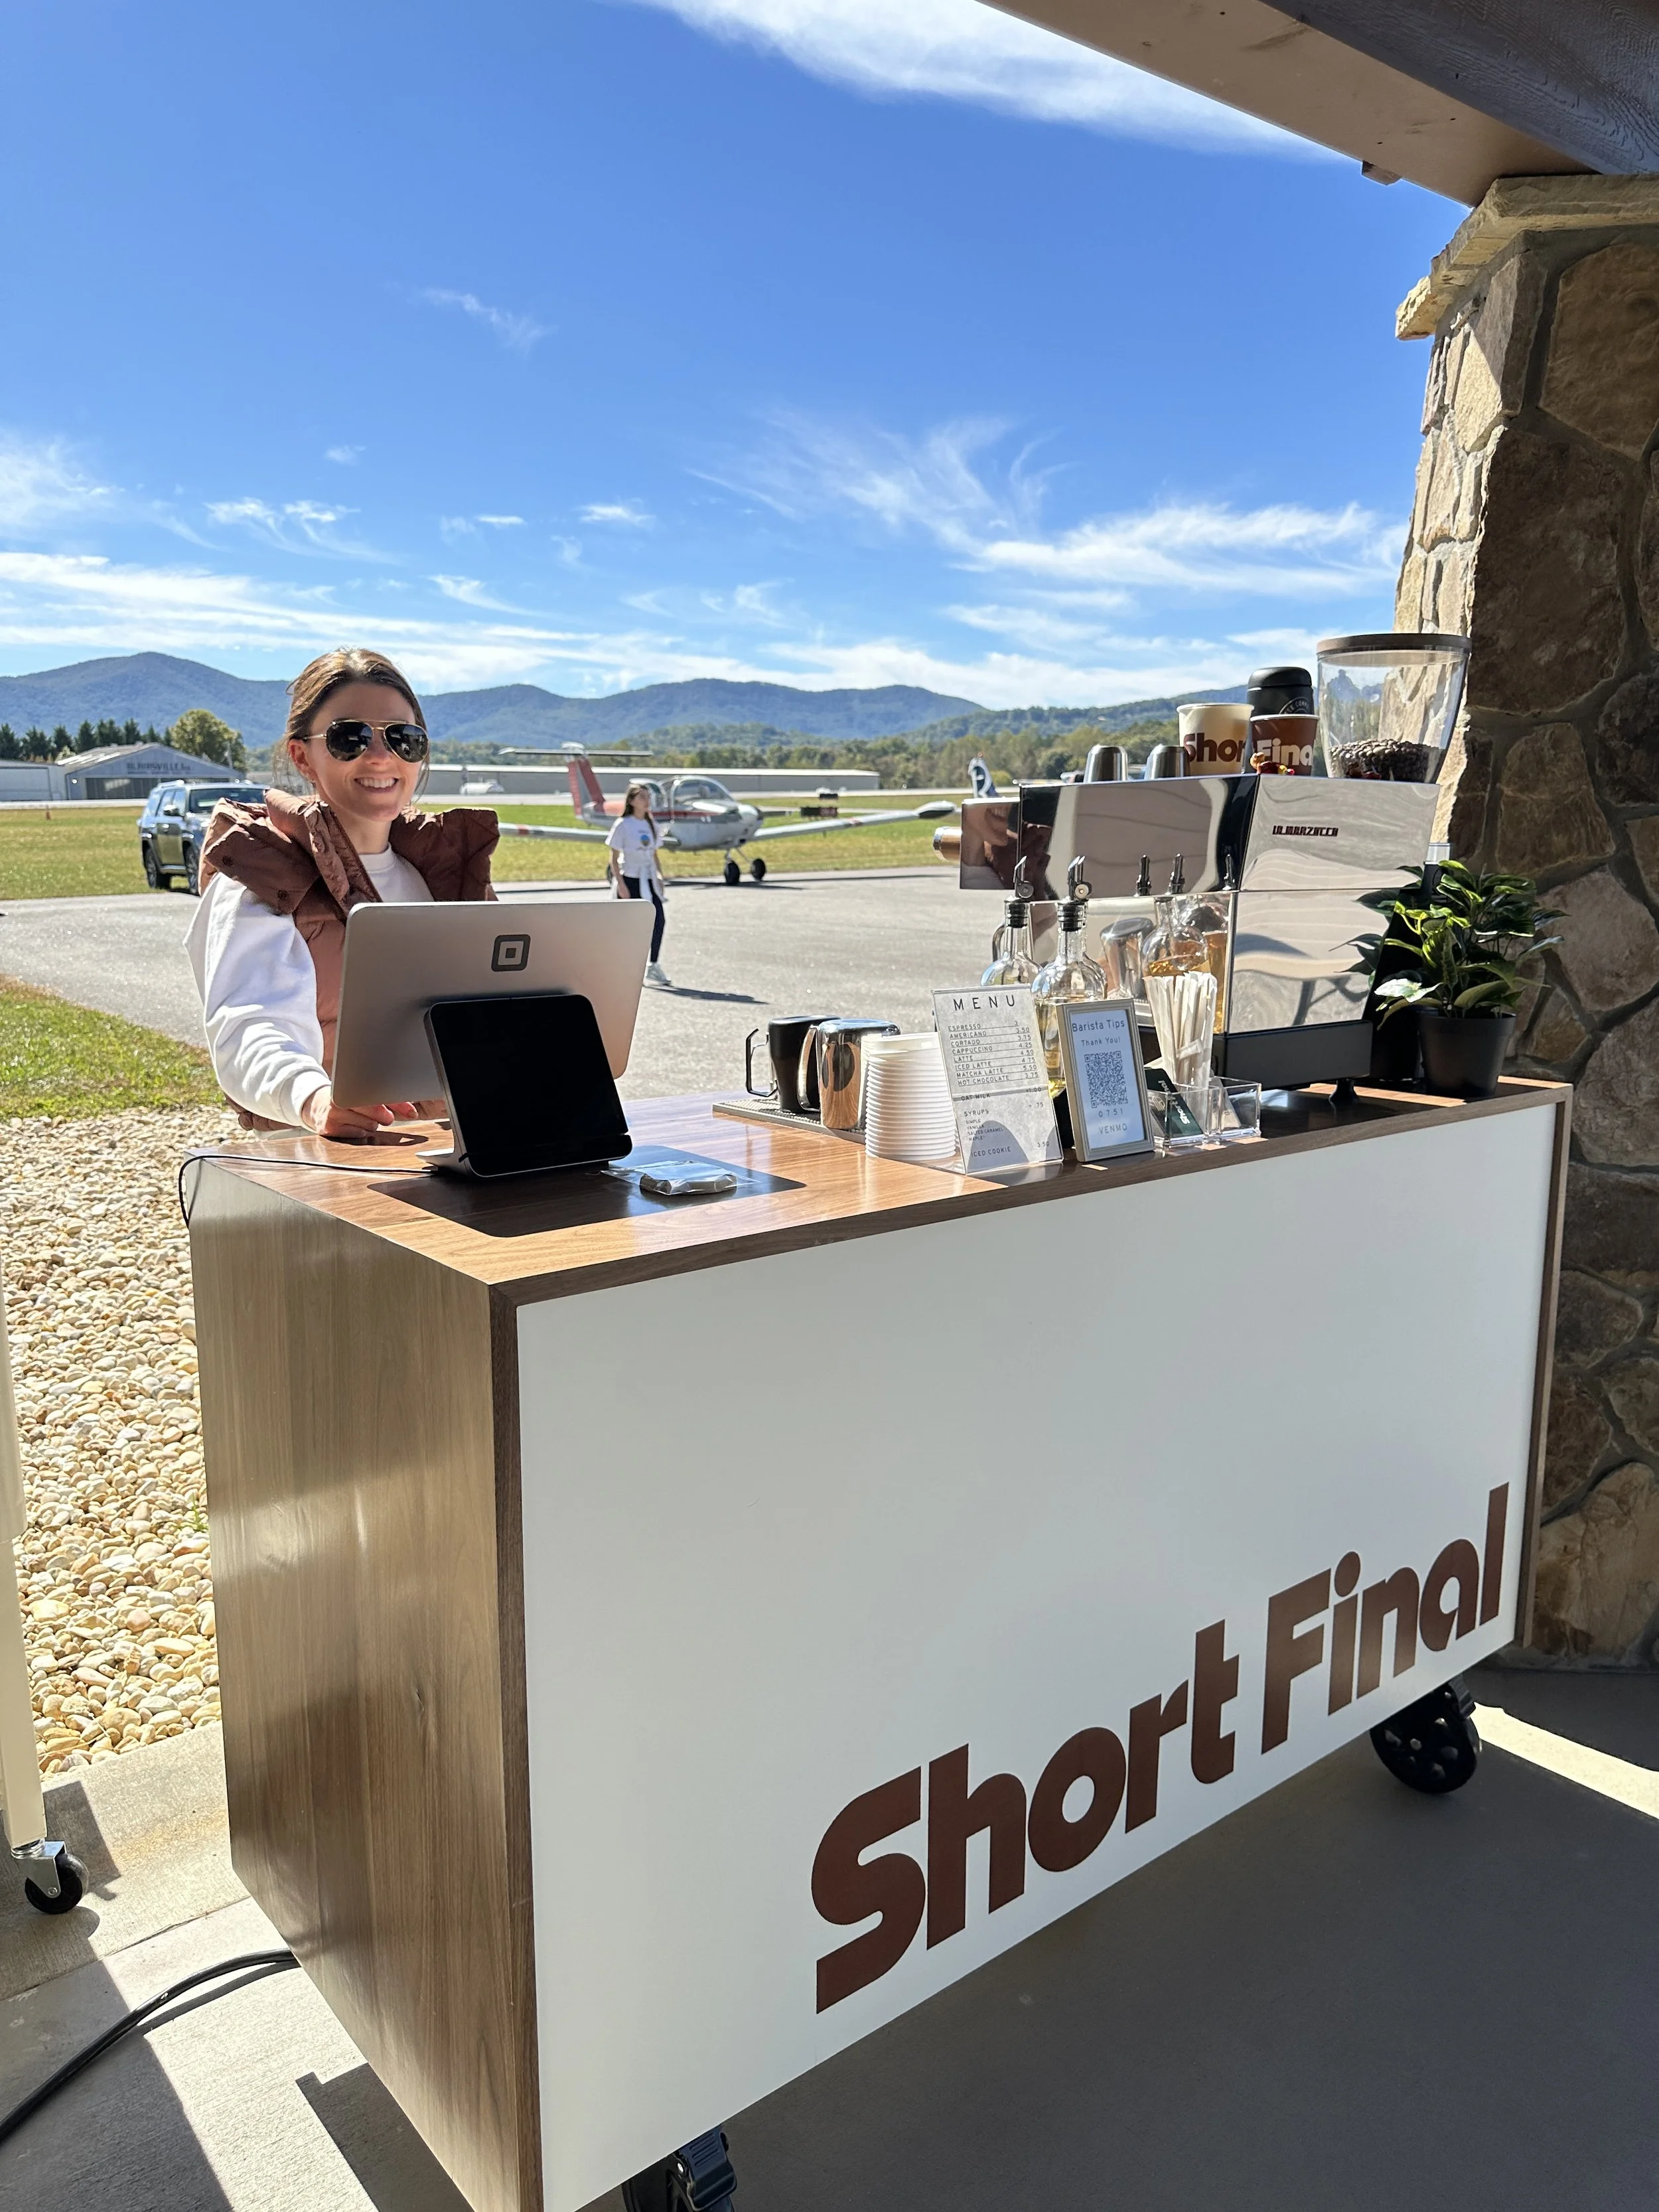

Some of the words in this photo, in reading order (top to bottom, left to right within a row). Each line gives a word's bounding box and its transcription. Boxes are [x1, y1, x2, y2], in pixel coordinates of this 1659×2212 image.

[1184, 733, 1246, 762] Shor
[1257, 738, 1313, 766] Fina
[953, 994, 1015, 1011] MENU
[1072, 1020, 1104, 1032] Barista
[1106, 1019, 1125, 1030] Tips
[950, 1031, 987, 1039] AMERICANO
[1080, 1038, 1103, 1047] Thank
[1106, 1036, 1121, 1045] You!
[952, 1046, 993, 1055] CAPPUCCINO
[974, 1074, 1009, 1084] CHOCOLATE
[964, 1108, 989, 1117] SYRUPS
[1098, 1108, 1123, 1118] 0751
[1098, 1123, 1127, 1134] VENMO
[988, 1146, 1011, 1155] COOKIE
[811, 1619, 1240, 2015] Short
[1260, 1481, 1510, 1755] Final
